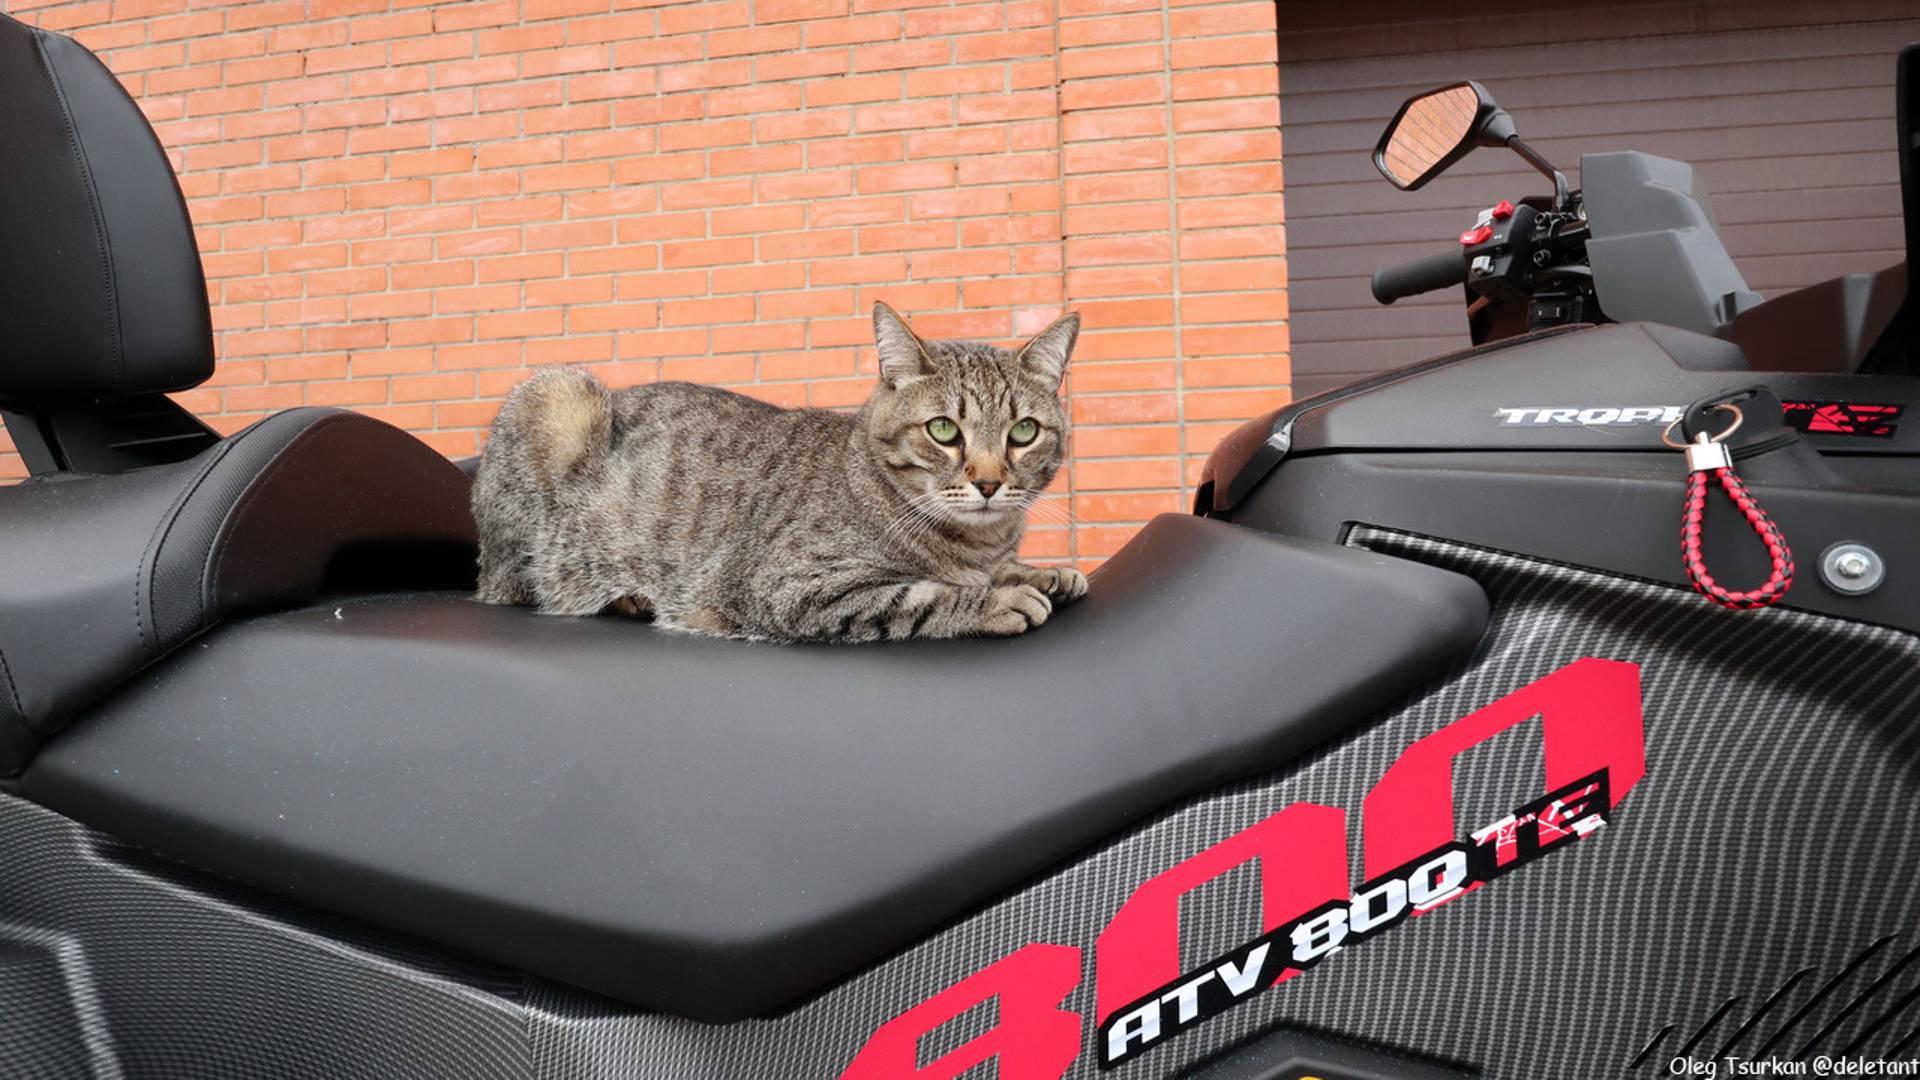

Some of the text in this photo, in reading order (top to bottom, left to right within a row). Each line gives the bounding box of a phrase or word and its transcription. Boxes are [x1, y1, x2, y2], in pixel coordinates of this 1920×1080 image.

[1499, 406, 1687, 426] TROPH
[1108, 942, 1271, 1061] ATV
[1289, 850, 1467, 962] 800
